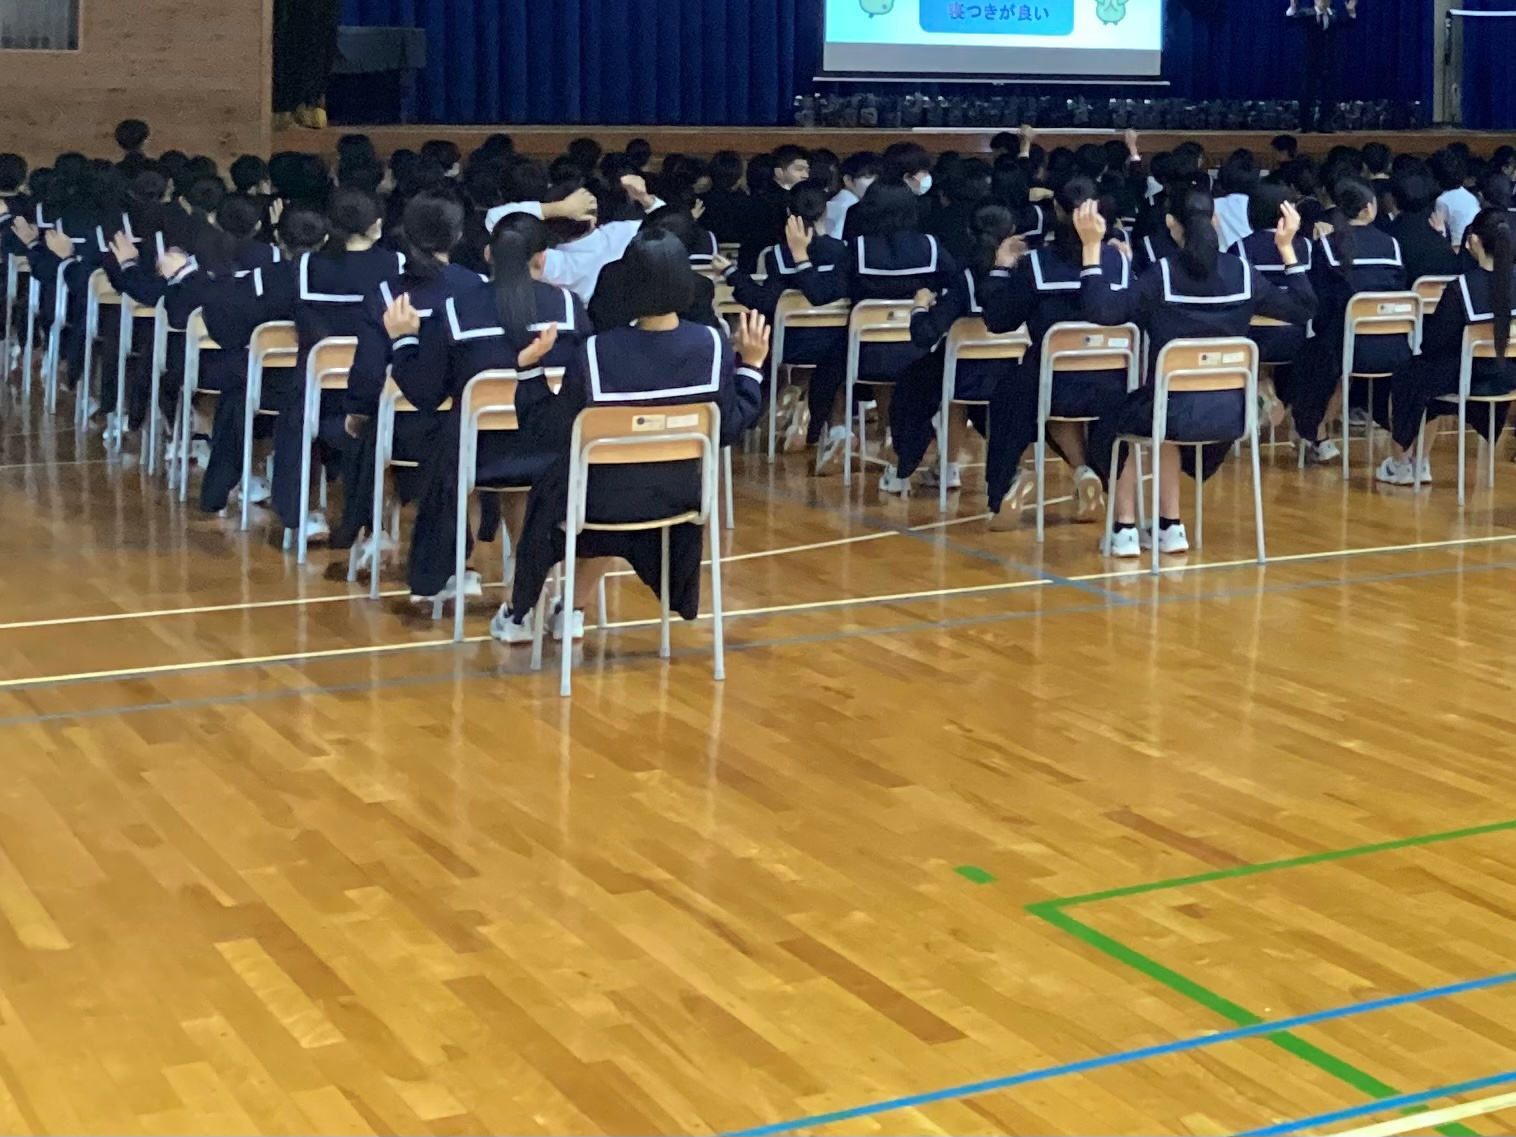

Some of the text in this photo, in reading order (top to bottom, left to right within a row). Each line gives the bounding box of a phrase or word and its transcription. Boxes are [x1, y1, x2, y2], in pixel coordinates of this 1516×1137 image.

[949, 2, 1050, 22] 寝つきが良い
